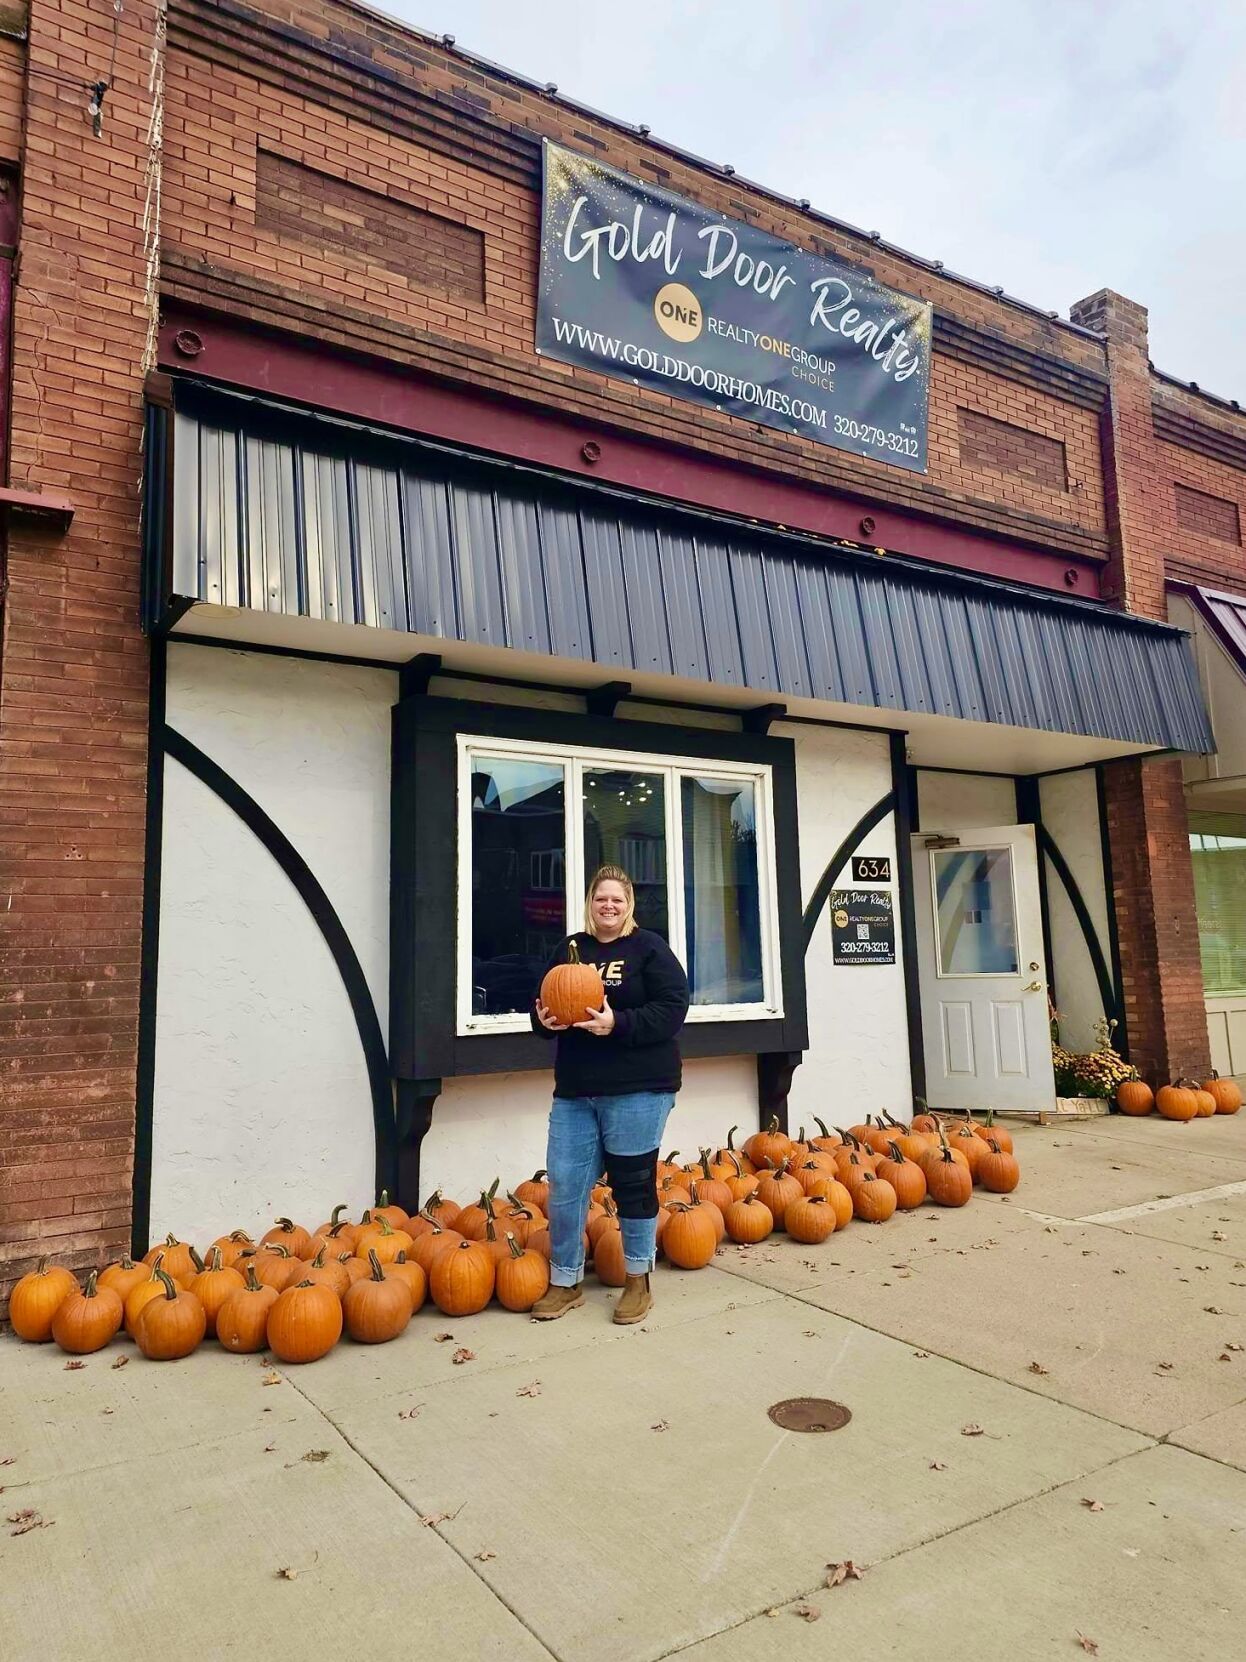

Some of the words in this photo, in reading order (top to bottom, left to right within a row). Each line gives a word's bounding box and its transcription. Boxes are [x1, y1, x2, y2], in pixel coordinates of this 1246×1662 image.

[564, 195, 683, 280] Gold
[698, 225, 797, 301] Door
[810, 276, 919, 382] Realty
[659, 300, 698, 327] ONE
[552, 317, 827, 428] WWW.GOLDDOORHOMES.COM
[833, 414, 919, 458] 320-279-3212
[791, 366, 835, 393] CHOICE
[858, 859, 890, 878] 634
[840, 941, 889, 953] 320-279-3212
